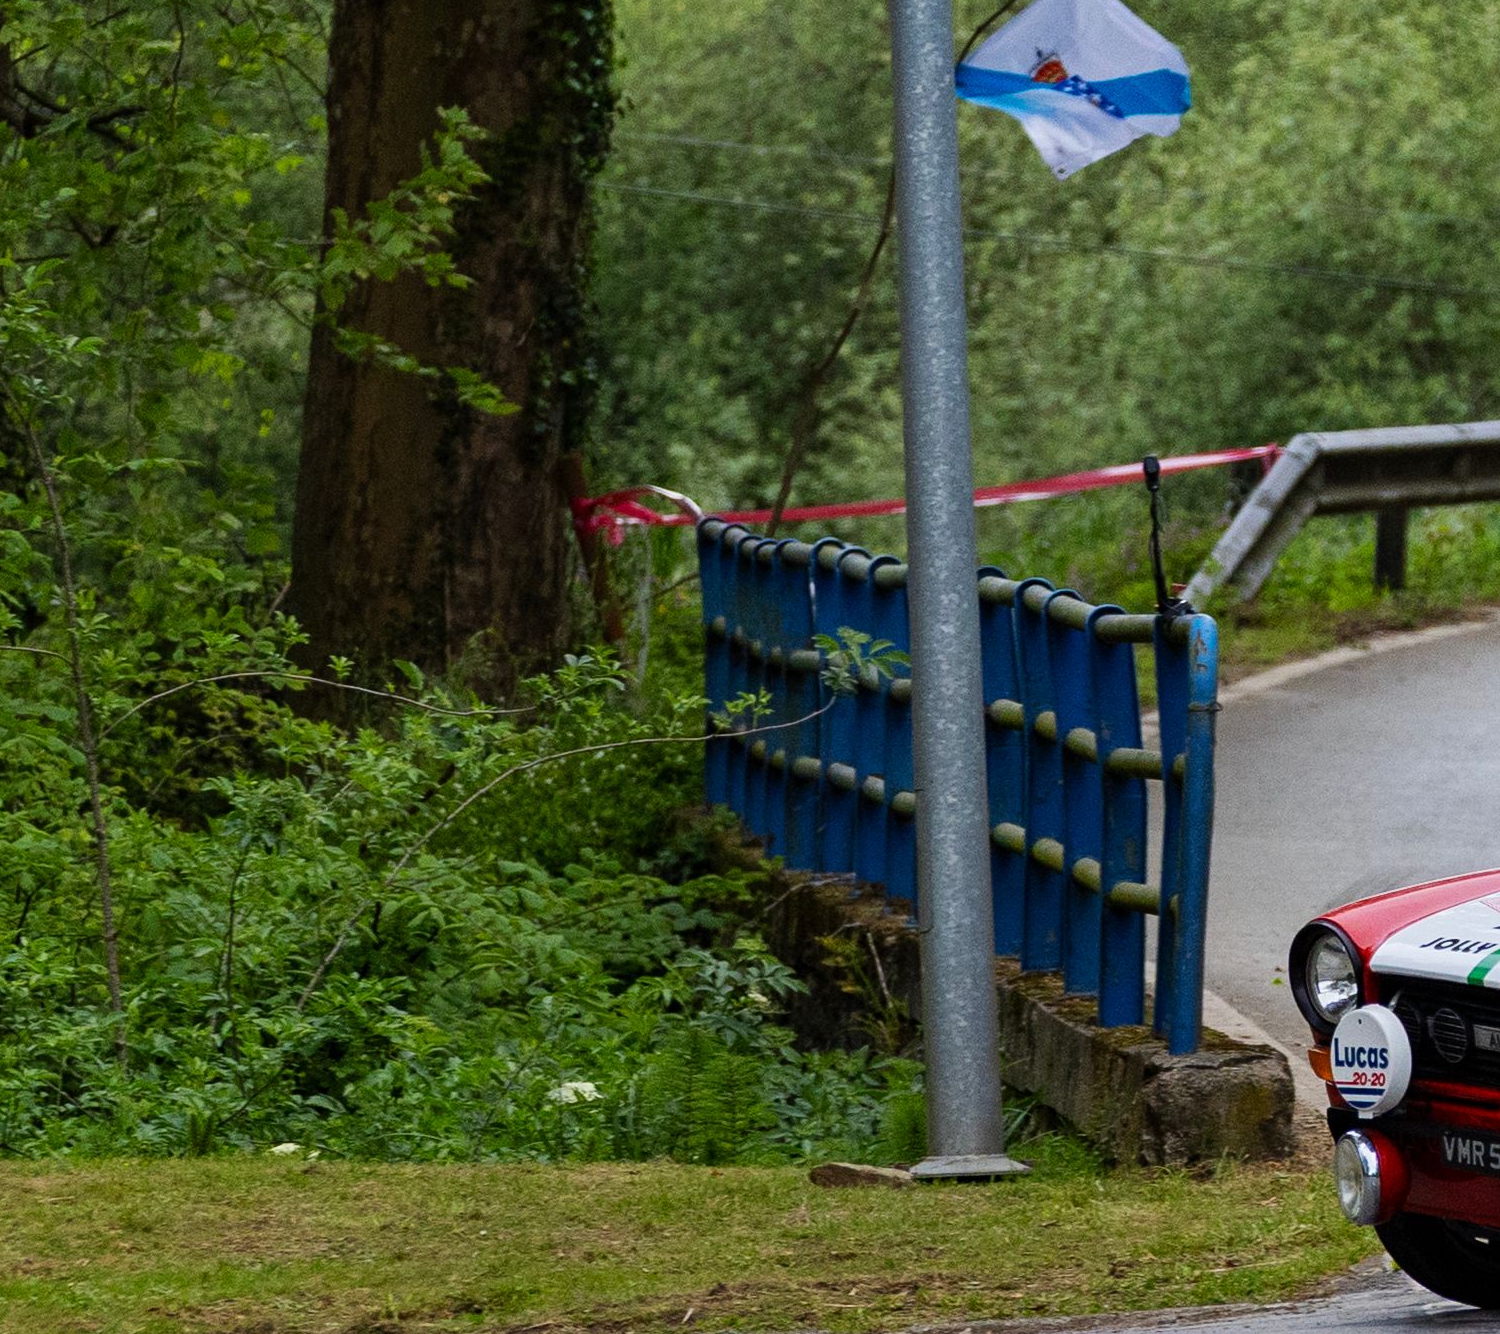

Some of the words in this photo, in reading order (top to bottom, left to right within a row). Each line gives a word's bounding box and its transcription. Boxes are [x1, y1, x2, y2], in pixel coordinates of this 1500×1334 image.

[1420, 937, 1498, 954] JOLLY
[1334, 1037, 1389, 1069] Lucas
[1443, 1135, 1485, 1167] VMR
